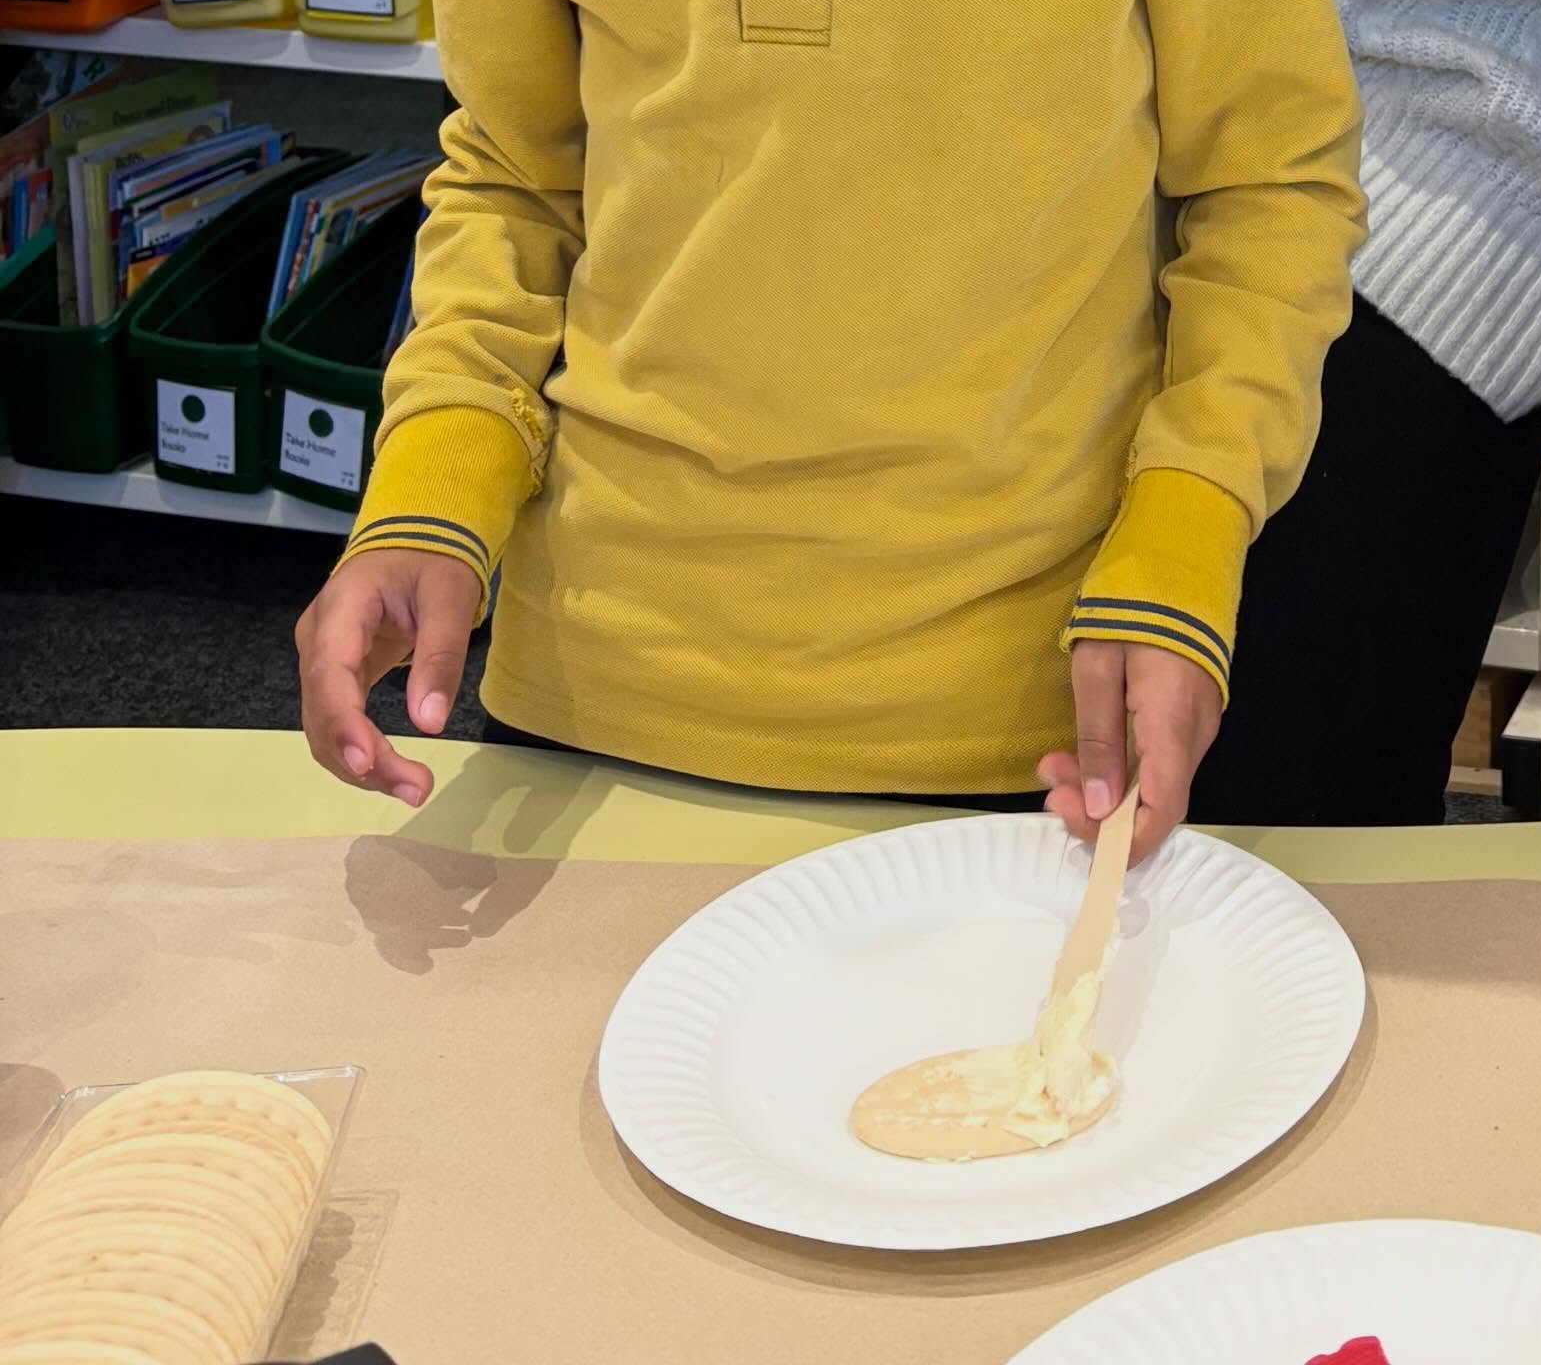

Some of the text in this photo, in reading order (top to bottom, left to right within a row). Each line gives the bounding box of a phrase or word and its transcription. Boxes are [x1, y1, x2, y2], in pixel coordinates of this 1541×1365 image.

[161, 422, 209, 441] Take Home
[286, 432, 336, 457] Take Home
